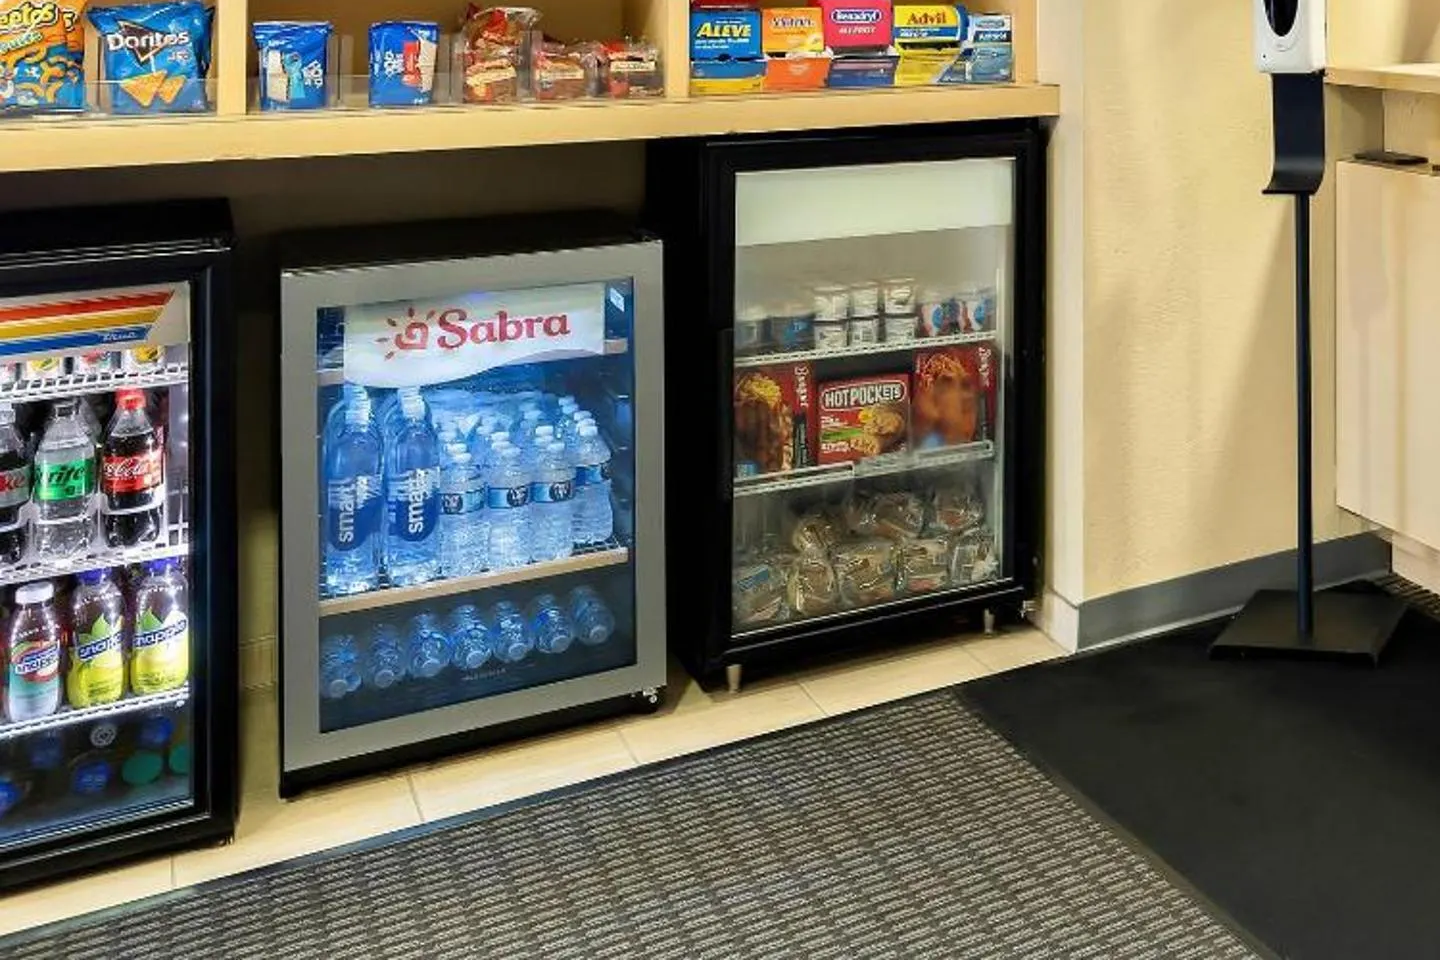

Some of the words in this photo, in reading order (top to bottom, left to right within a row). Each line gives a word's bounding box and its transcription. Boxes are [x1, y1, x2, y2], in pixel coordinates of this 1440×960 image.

[906, 11, 947, 26] Advil
[696, 21, 752, 38] ALEVE
[106, 31, 190, 51] Doritos
[436, 308, 572, 351] Sabra
